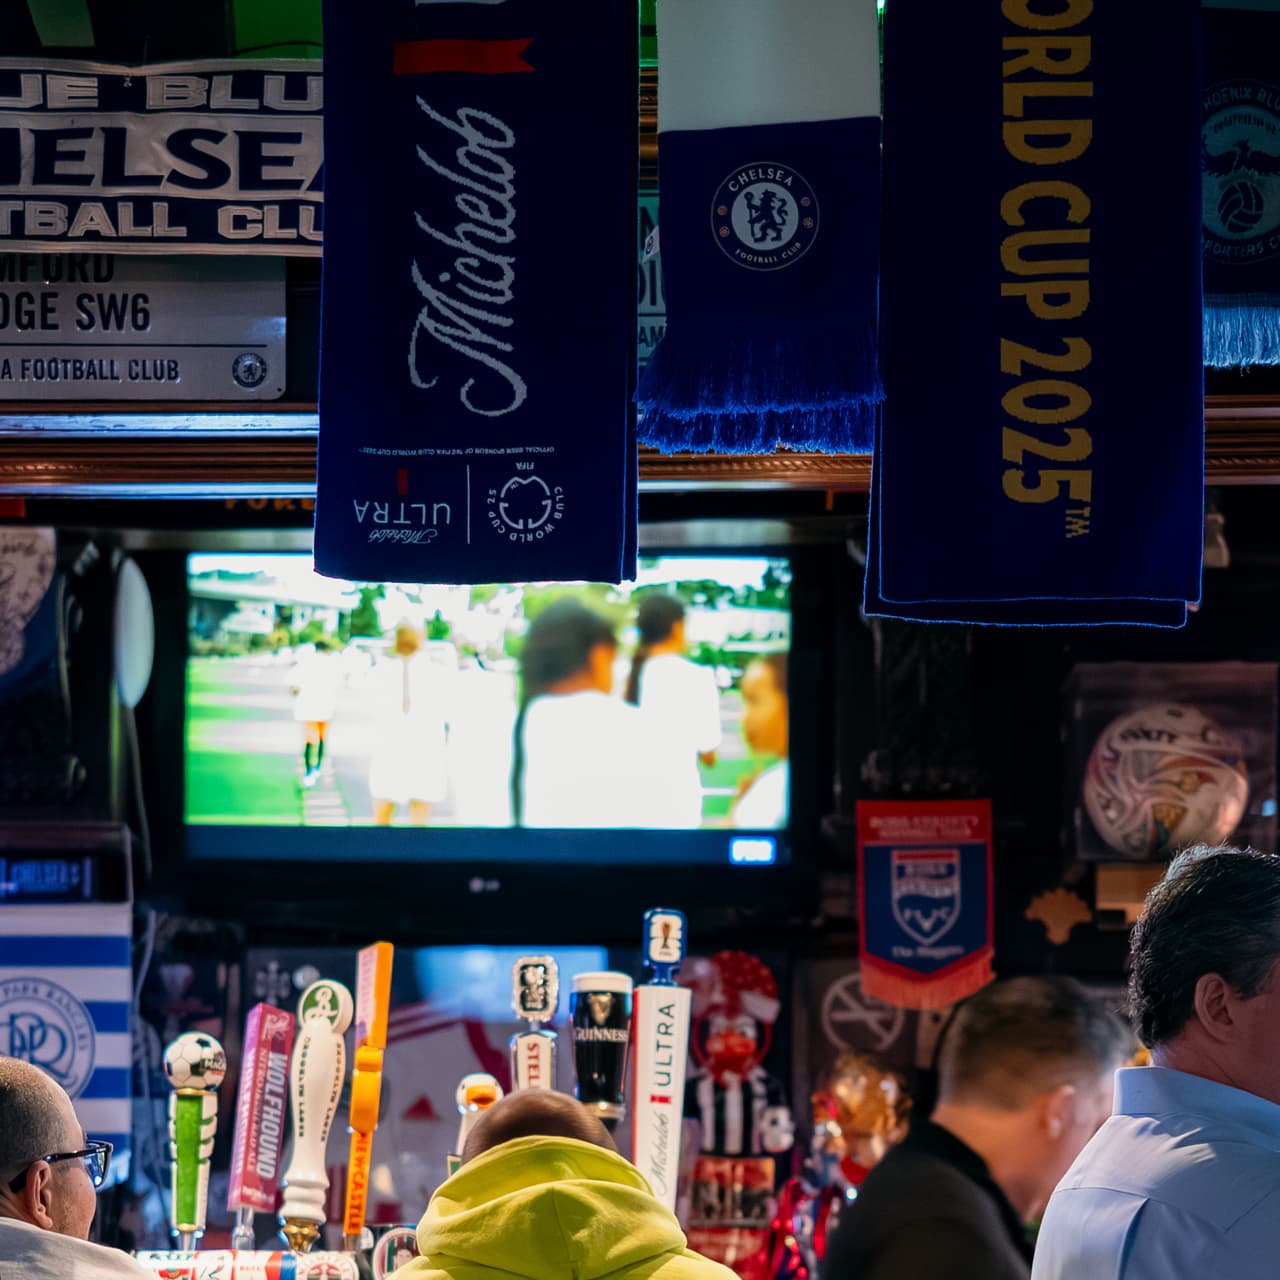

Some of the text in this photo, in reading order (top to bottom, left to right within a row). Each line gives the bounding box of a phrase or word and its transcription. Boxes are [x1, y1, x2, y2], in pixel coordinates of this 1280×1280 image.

[728, 167, 794, 193] CHELSEA
[407, 95, 528, 418] Michelob
[734, 240, 802, 265] FOOTBALL CLUB
[999, 179, 1093, 321] CUP
[75, 293, 151, 332] SW6
[20, 358, 120, 382] FOOTBALL
[128, 359, 180, 382] CLUB
[352, 499, 451, 525] ULTRA
[553, 486, 565, 520] CLUB
[488, 510, 507, 535] CUP
[509, 521, 556, 543] WORLD
[367, 528, 438, 545] Michelob
[575, 1026, 629, 1043] GUINNESS
[654, 1002, 675, 1087] ULTRA
[255, 1051, 289, 1179] WOLFHOUND
[348, 1132, 369, 1231] NEWCASTLE
